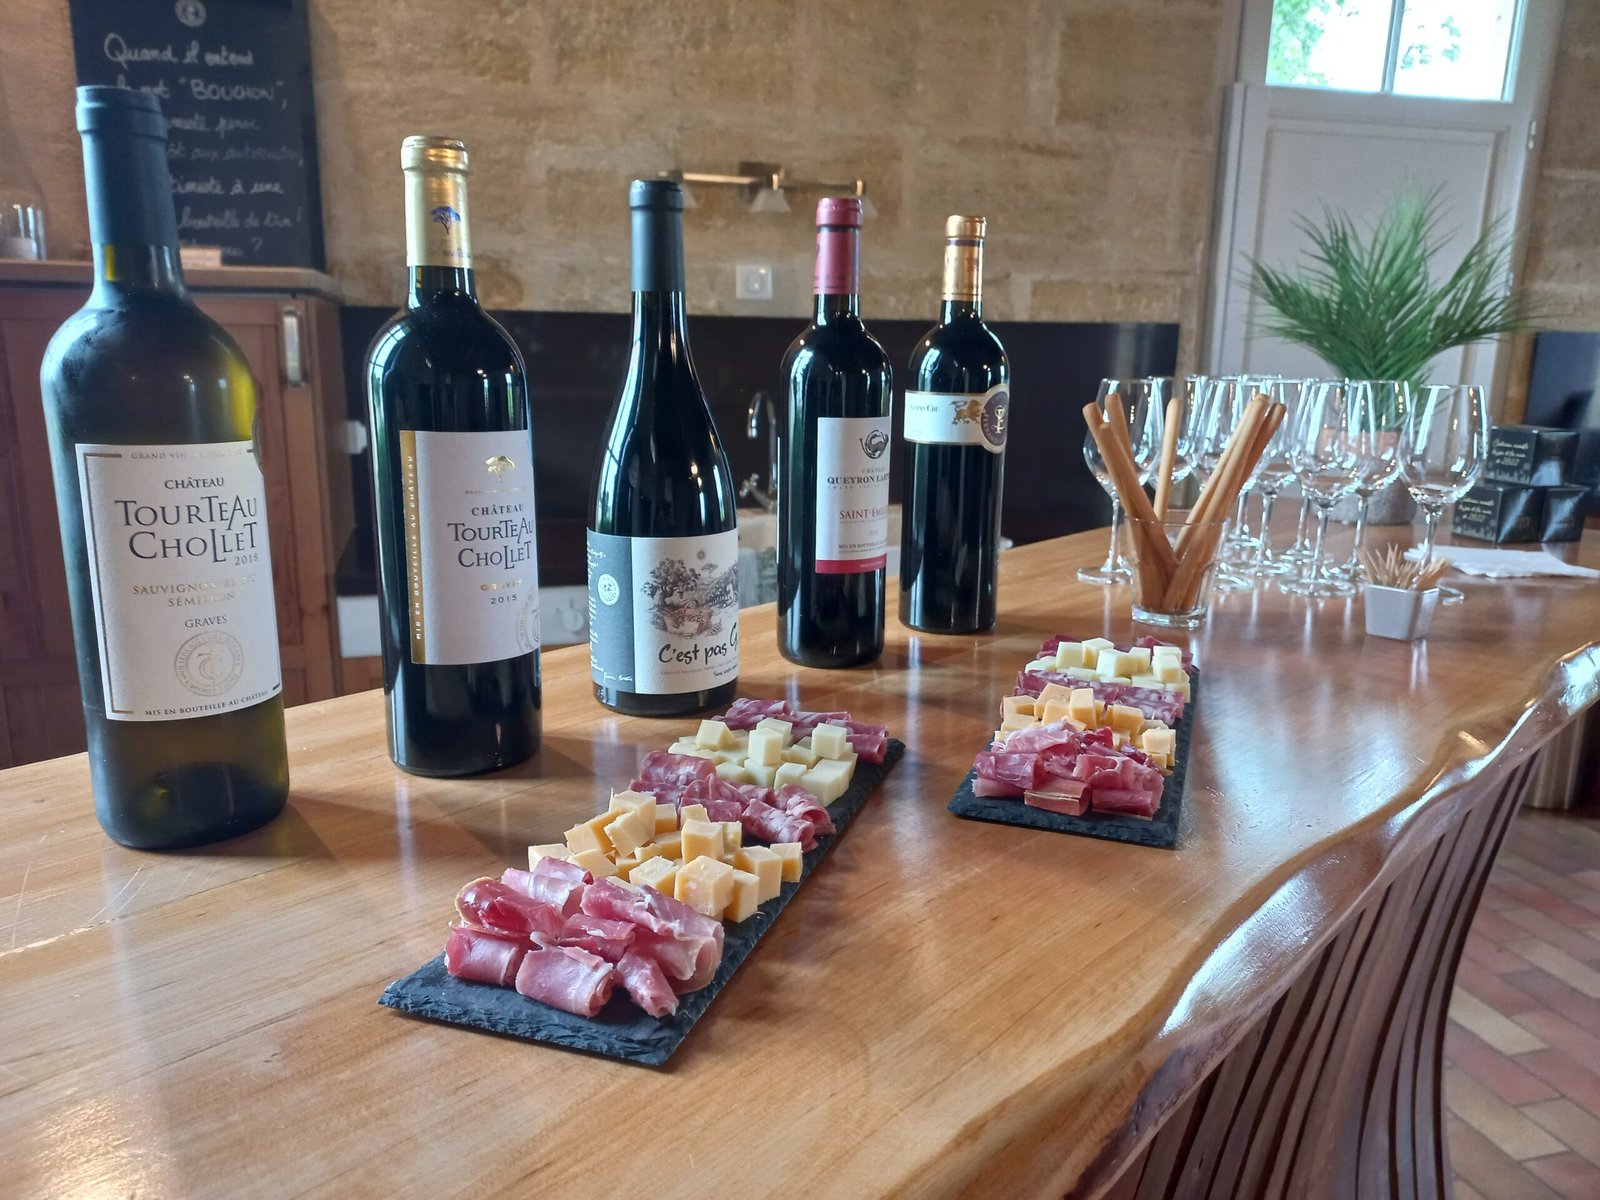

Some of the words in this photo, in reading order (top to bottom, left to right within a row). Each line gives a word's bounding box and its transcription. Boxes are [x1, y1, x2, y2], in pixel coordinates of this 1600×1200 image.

[104, 33, 178, 69] Quand
[183, 41, 199, 64] il
[205, 46, 254, 65] entend
[249, 183, 284, 194] une
[164, 477, 225, 490] CHÂTEAU
[827, 474, 874, 485] QUEYRON
[115, 495, 257, 531] TOURTEAU
[471, 503, 524, 516] CHÂTEAU
[447, 517, 534, 544] TOURTEAU
[129, 521, 258, 564] CHOLLET
[458, 541, 532, 570] CHOLLET
[133, 581, 217, 595] SAUVIGNON
[224, 574, 255, 588] BLC
[490, 594, 518, 605] 2015
[184, 615, 228, 628] GRAVES
[658, 643, 700, 665] C'est
[704, 643, 728, 665] pas
[180, 701, 226, 714] BOUTEILLE
[229, 698, 240, 706] AU
